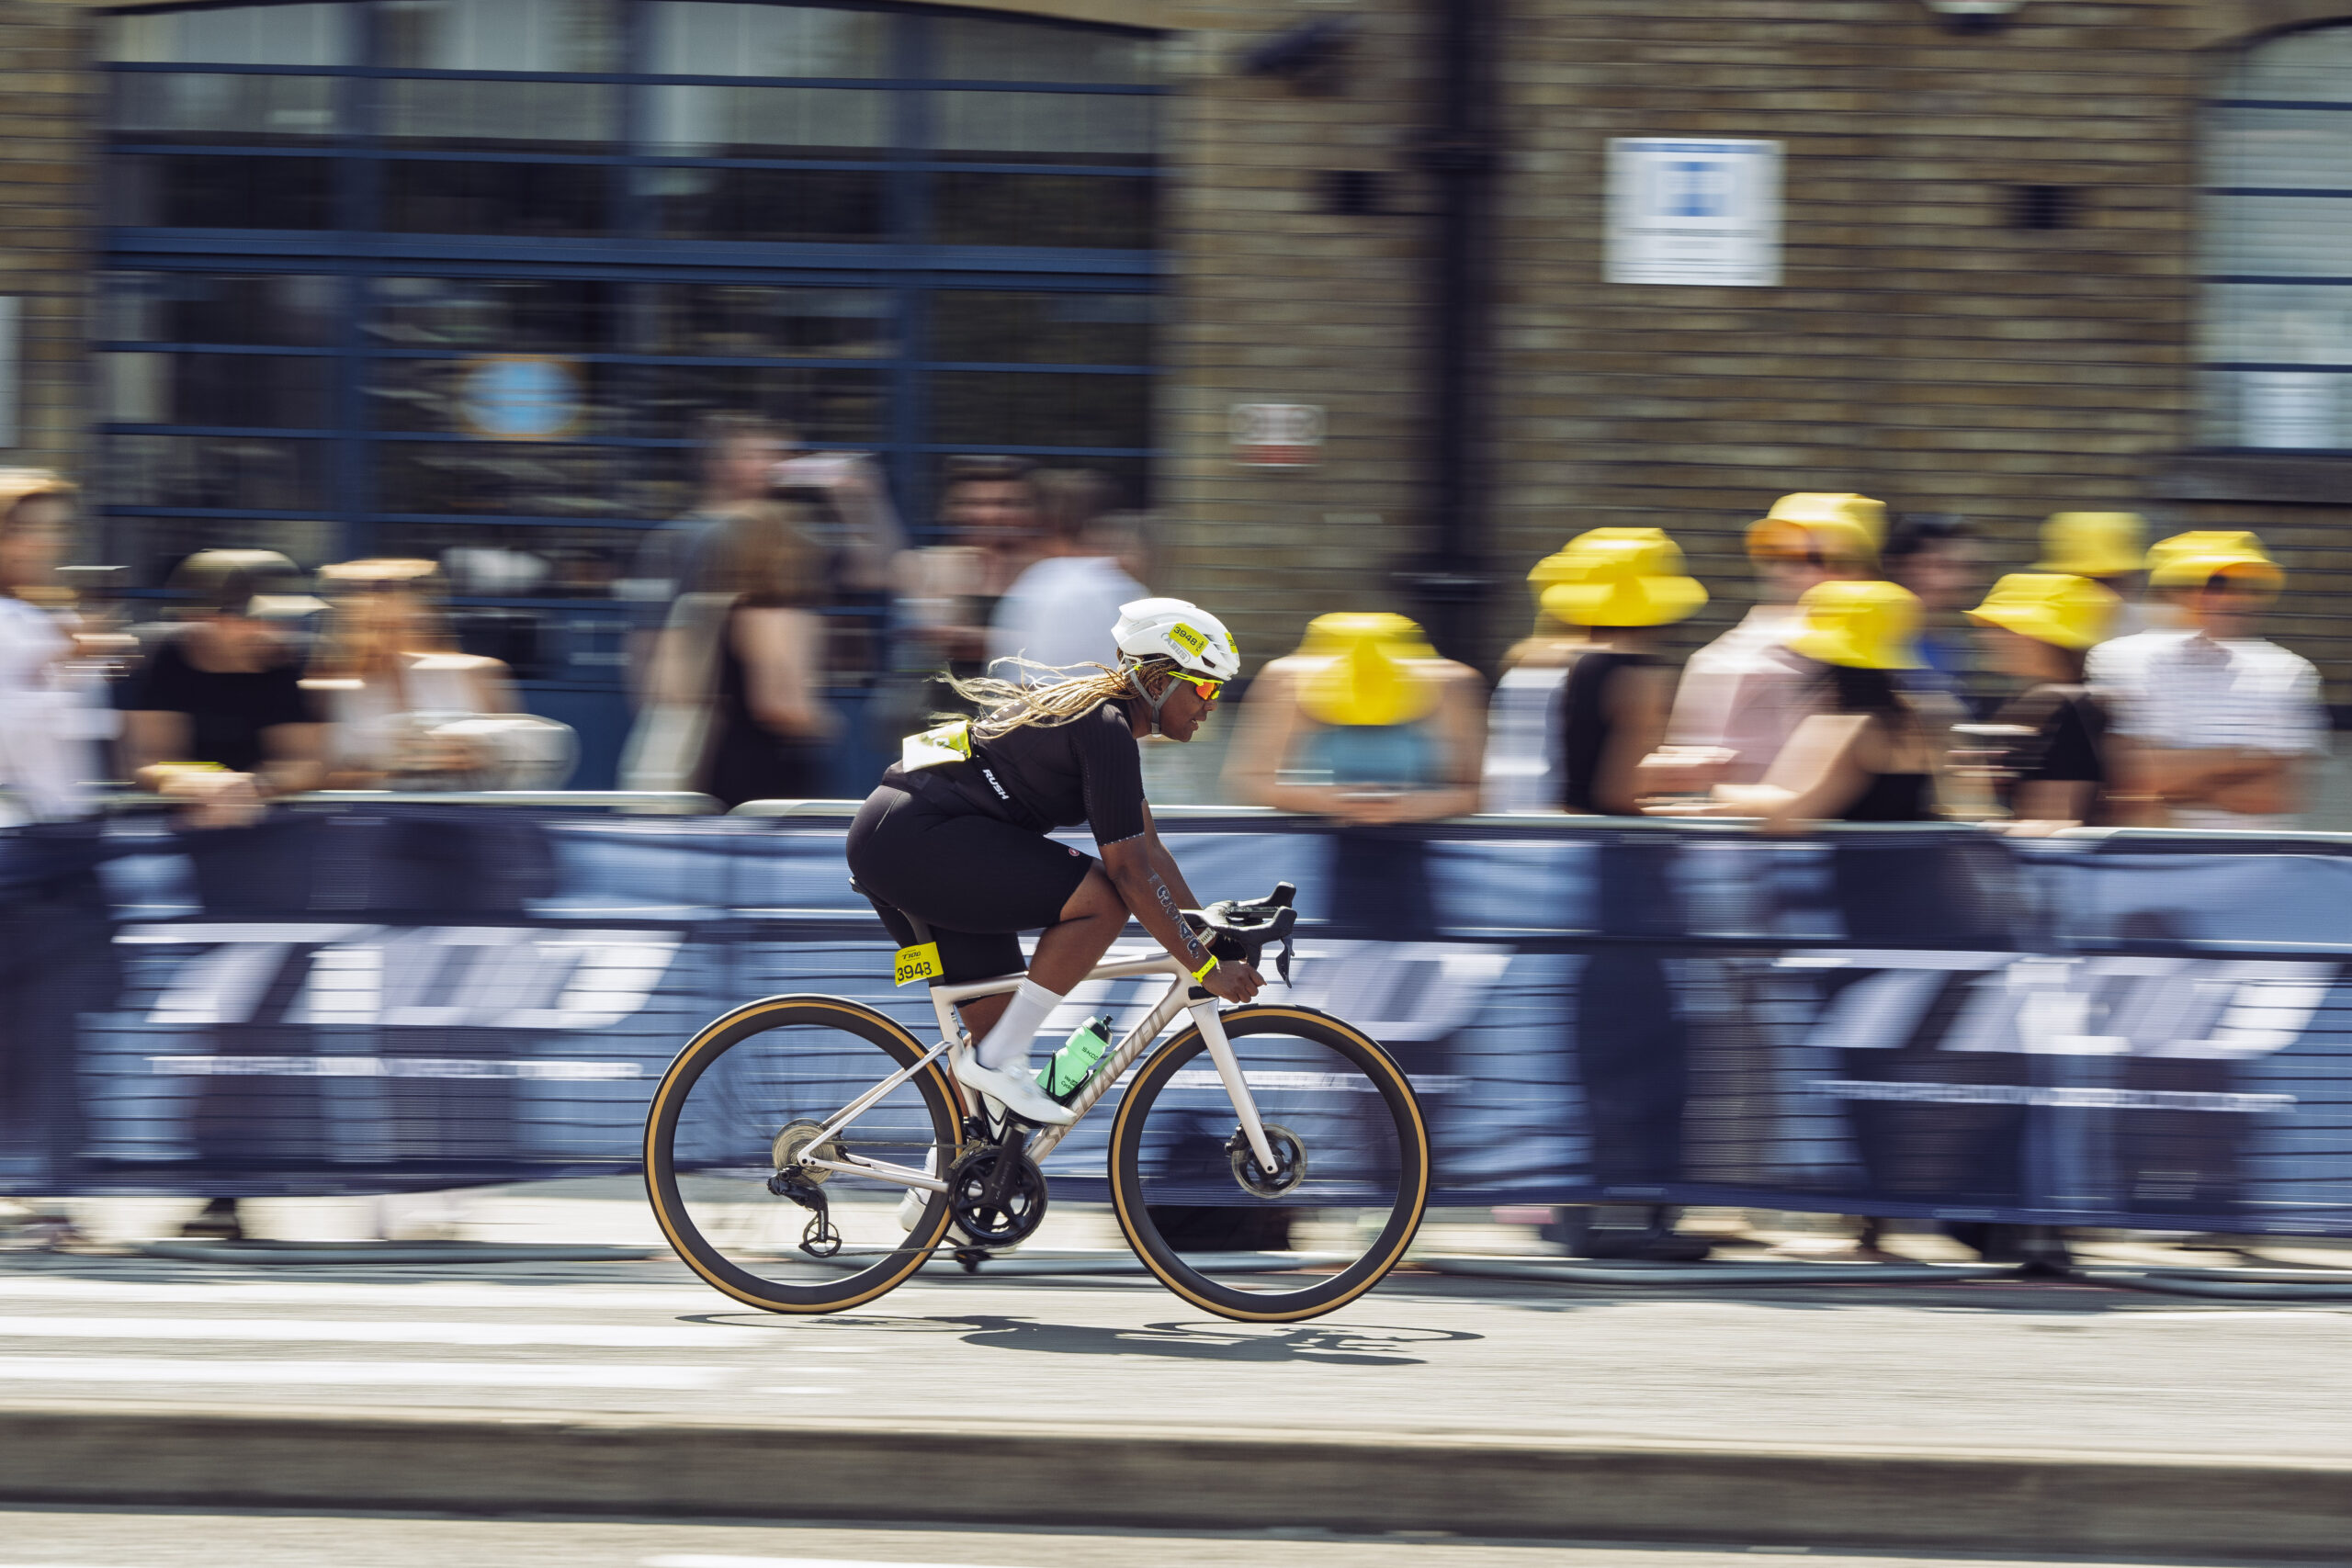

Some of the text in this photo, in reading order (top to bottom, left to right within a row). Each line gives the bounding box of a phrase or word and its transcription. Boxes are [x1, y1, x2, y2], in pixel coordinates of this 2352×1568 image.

[1173, 626, 1198, 646] 3948
[982, 769, 1010, 800] RUSH
[897, 961, 933, 982] 3948
